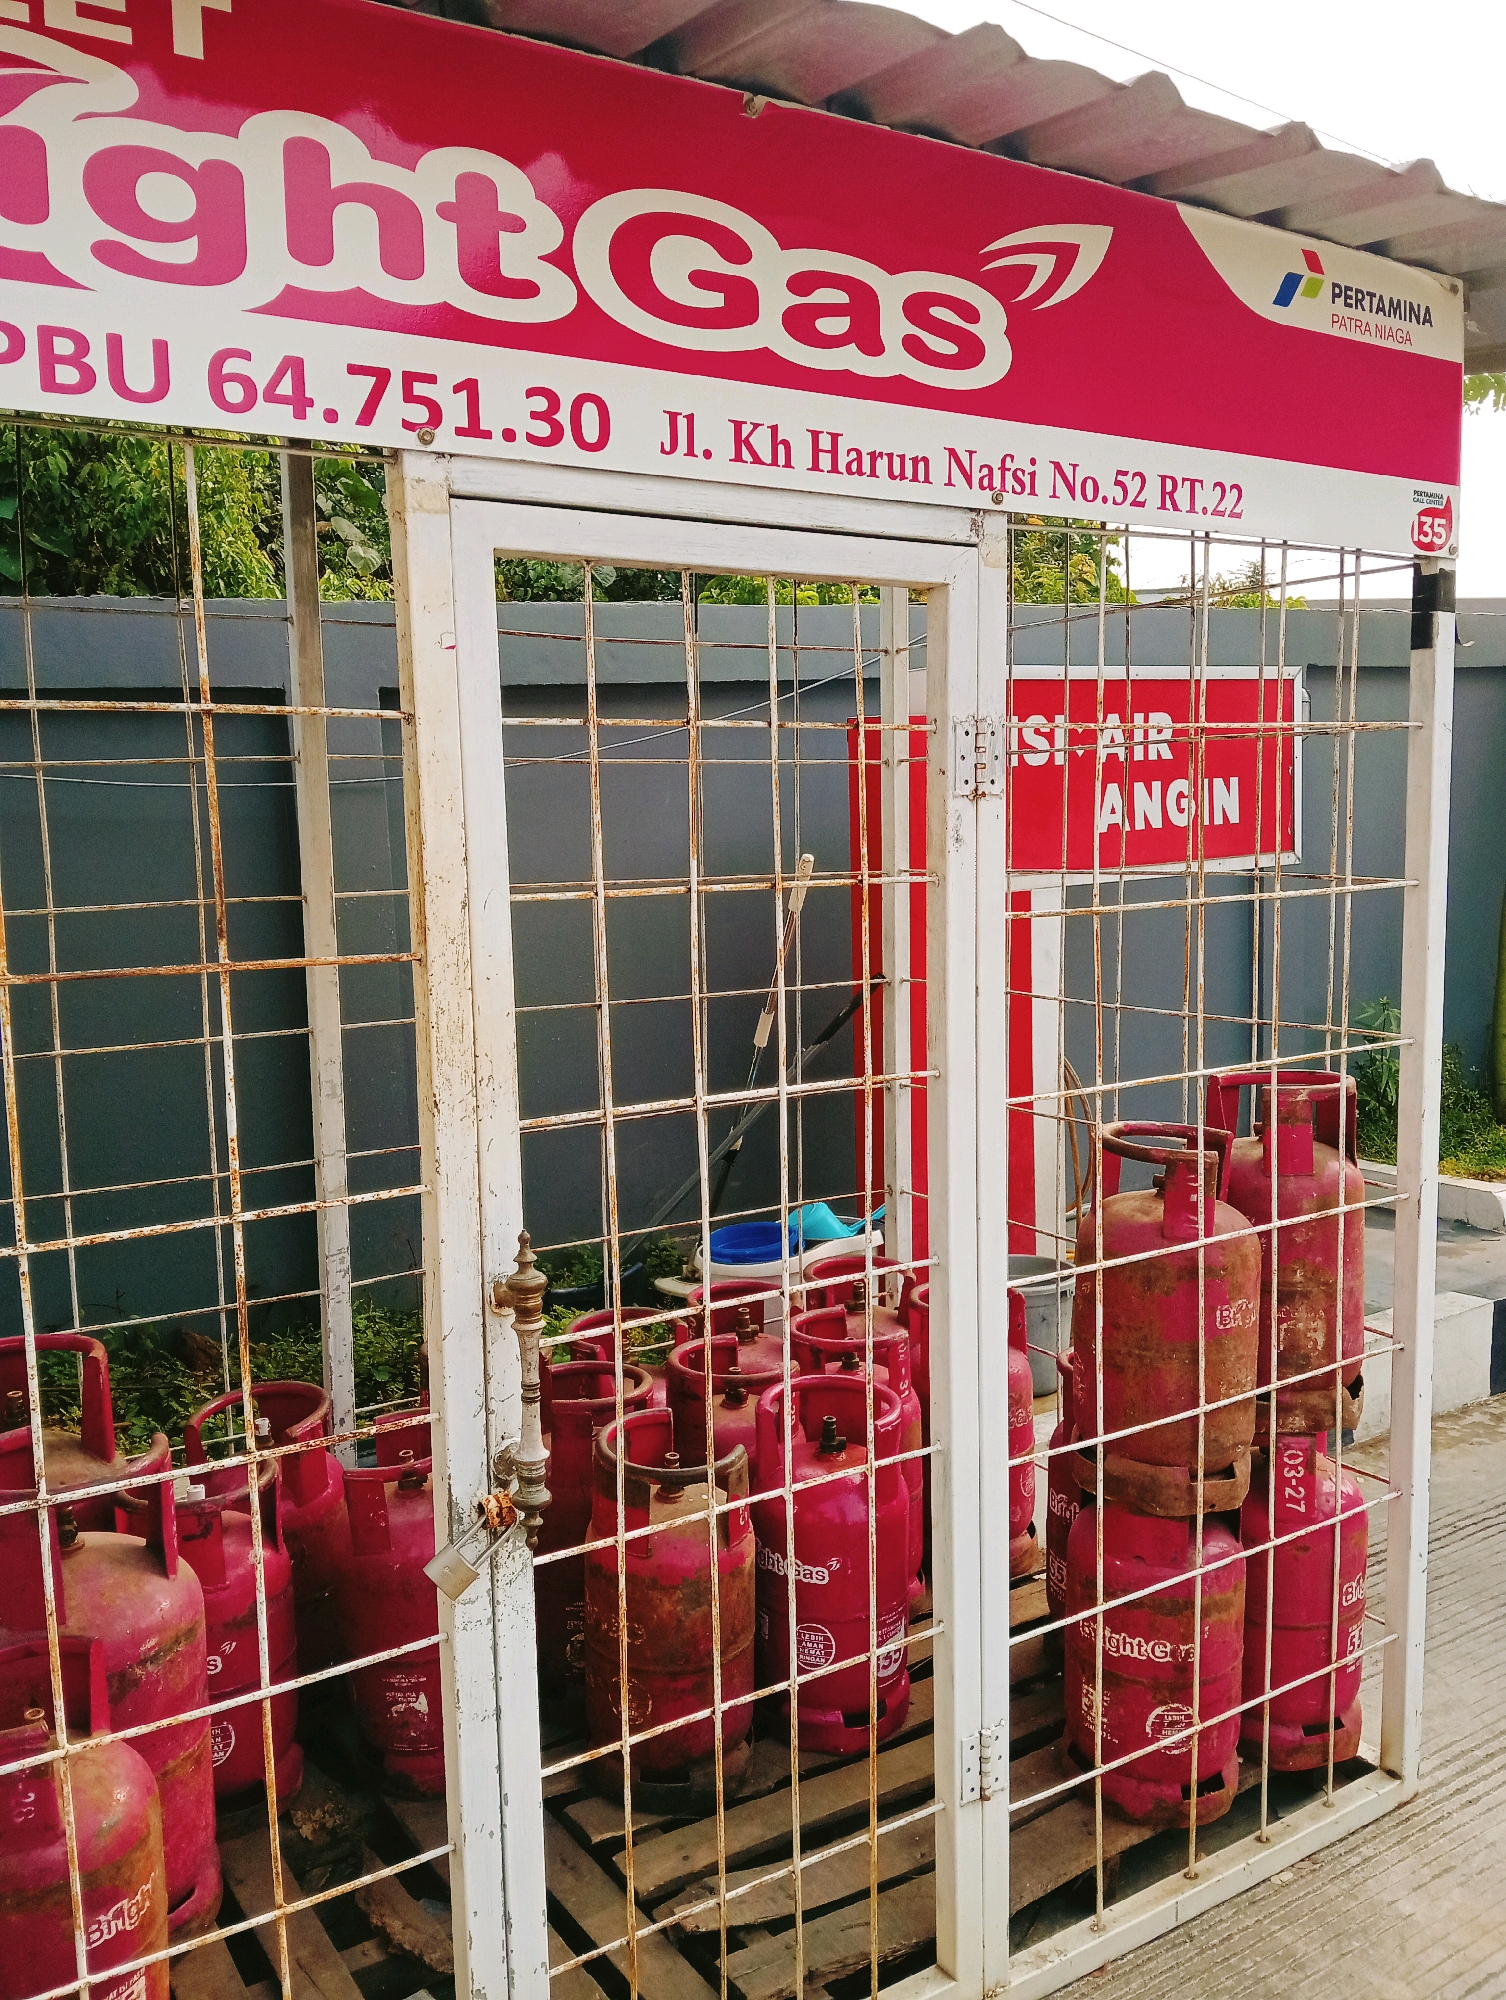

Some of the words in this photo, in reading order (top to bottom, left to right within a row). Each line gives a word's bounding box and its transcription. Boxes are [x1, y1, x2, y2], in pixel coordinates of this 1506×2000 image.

[1331, 281, 1433, 328] PERTAMINA
[1331, 313, 1372, 337] PATRA
[1374, 323, 1413, 346] NIAGA
[207, 346, 612, 453] 64.751.30
[728, 418, 795, 471] Kh
[805, 428, 934, 486] Harun
[943, 446, 1039, 498] Nafsi
[1156, 473, 1244, 520] RT.22
[1412, 496, 1425, 504] CALL
[1425, 498, 1444, 507] CENTER
[1413, 489, 1444, 501] PERTAMINA
[1413, 515, 1447, 545] 135
[1100, 711, 1174, 763] AIR
[1098, 776, 1240, 833] ANGIN
[1283, 1449, 1306, 1513] 03-27
